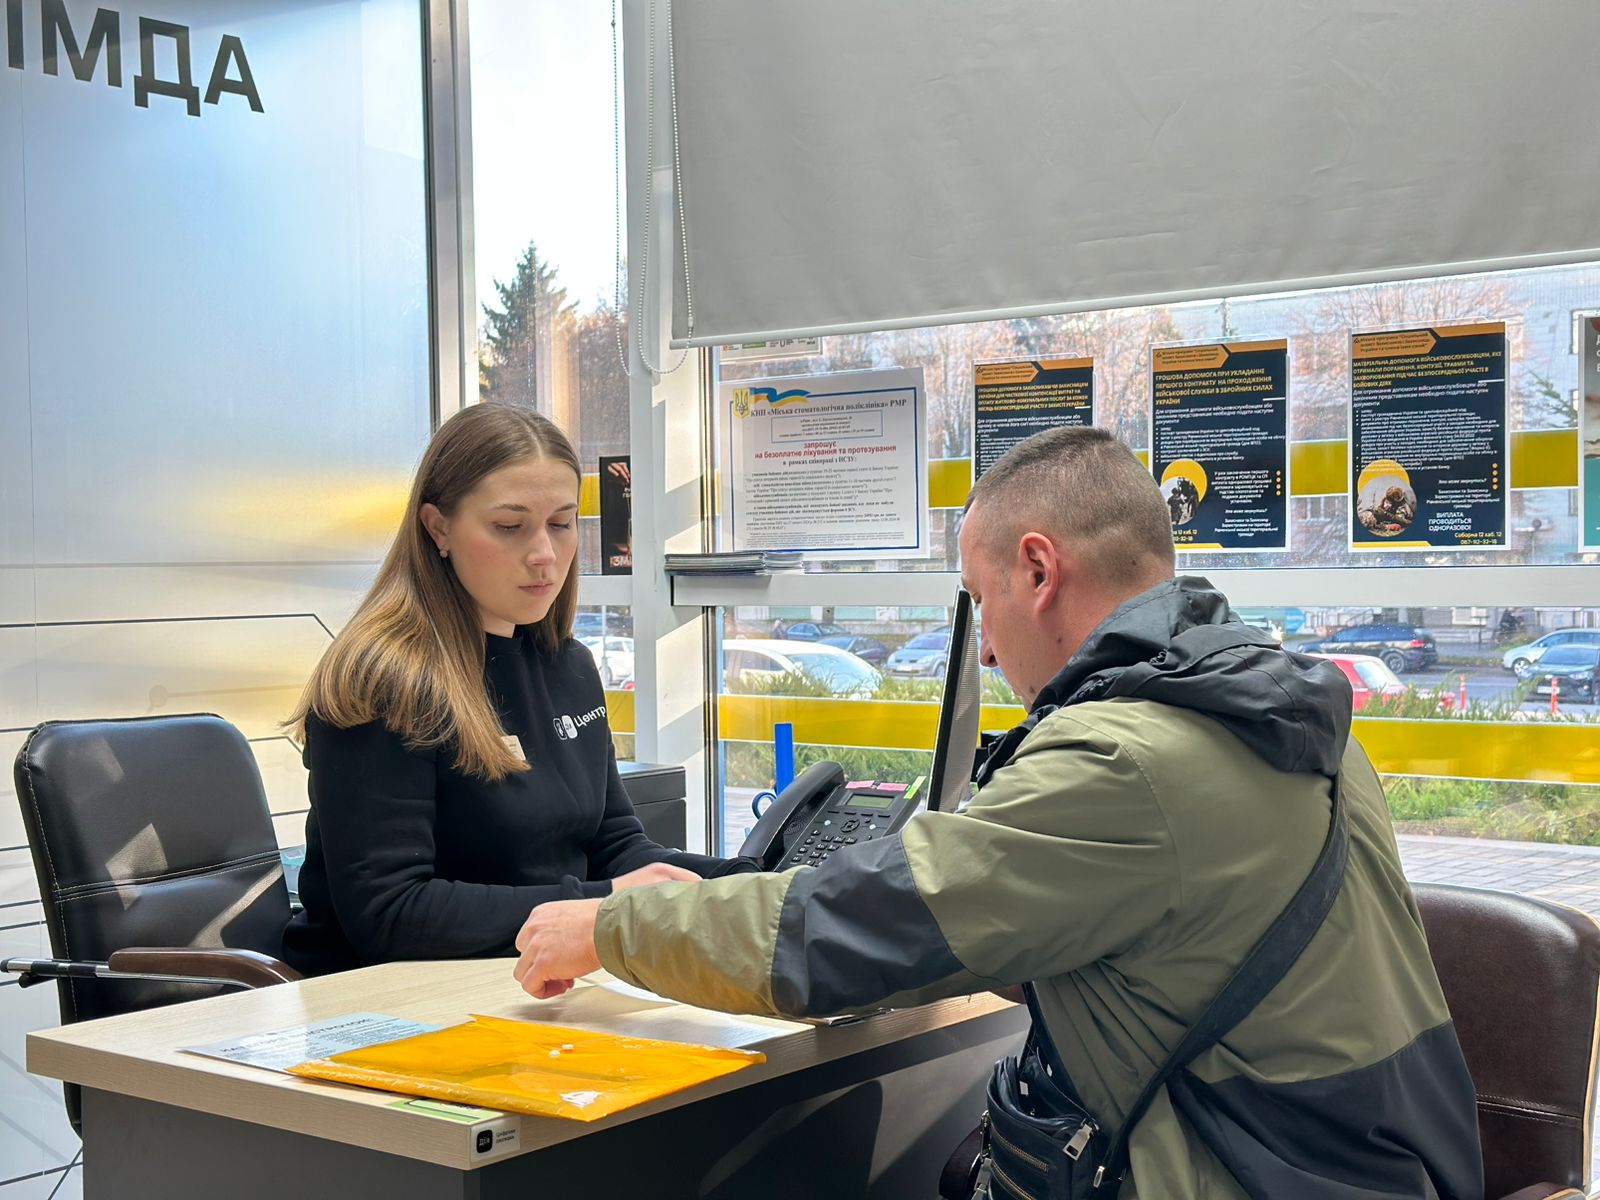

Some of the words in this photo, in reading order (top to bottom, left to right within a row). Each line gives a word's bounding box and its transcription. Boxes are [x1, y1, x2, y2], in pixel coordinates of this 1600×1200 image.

[890, 399, 907, 407] РМР
[804, 440, 837, 449] запрошує
[764, 450, 802, 458] безоплатне
[803, 448, 837, 457] лікування
[848, 445, 896, 454] протезування
[574, 706, 606, 727] Центр
